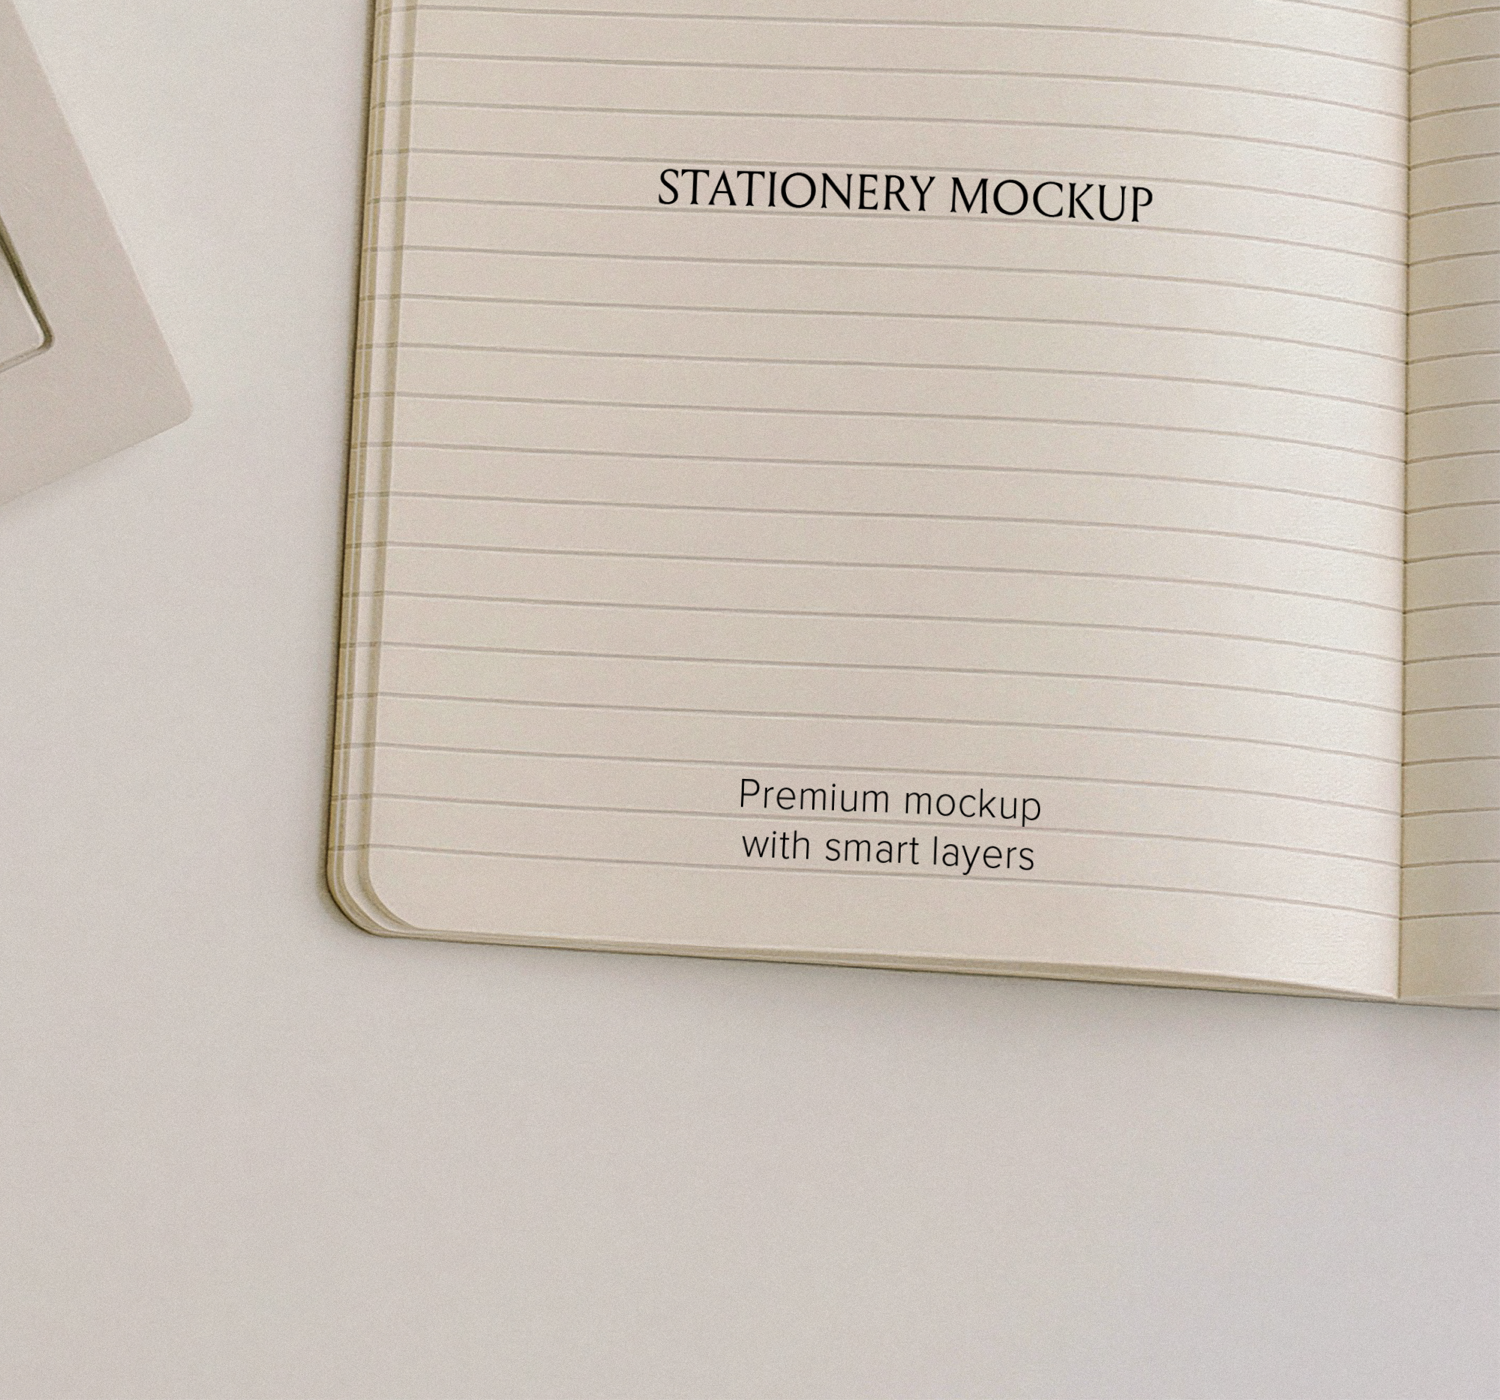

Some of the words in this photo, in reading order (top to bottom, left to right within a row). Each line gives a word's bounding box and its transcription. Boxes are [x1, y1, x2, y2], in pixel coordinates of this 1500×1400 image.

[658, 168, 936, 212] STATIONERY
[949, 176, 1153, 223] MOCKUP
[740, 778, 889, 813] Premium
[905, 787, 1041, 828] mockup
[741, 829, 810, 860] with
[825, 836, 921, 866] smart
[931, 835, 1035, 876] layers
